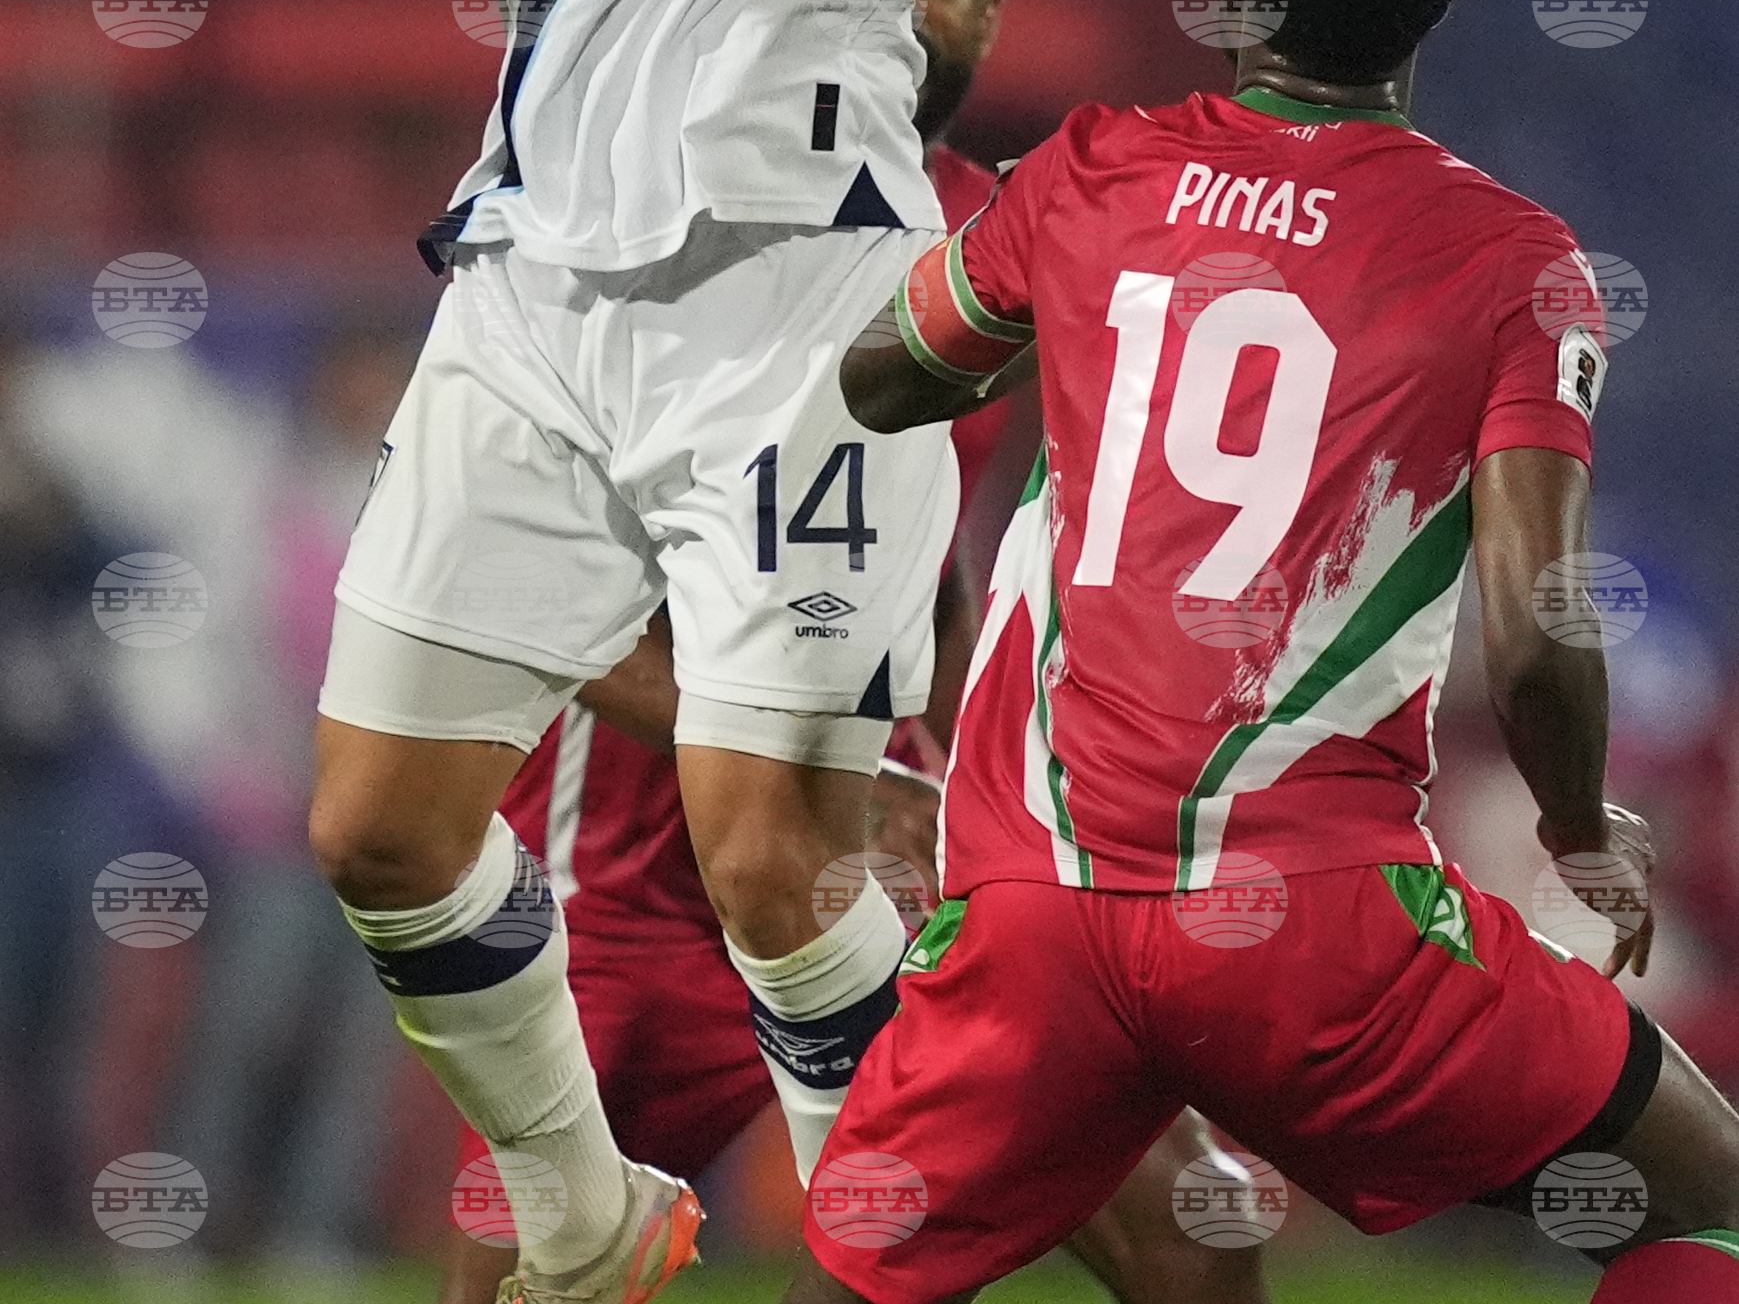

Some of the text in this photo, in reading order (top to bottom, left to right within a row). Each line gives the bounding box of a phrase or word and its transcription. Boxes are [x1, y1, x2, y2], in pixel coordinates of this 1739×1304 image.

[1165, 161, 1337, 247] PINAS
[1071, 270, 1339, 602] 19
[742, 442, 878, 573] 14
[795, 624, 849, 638] umbro
